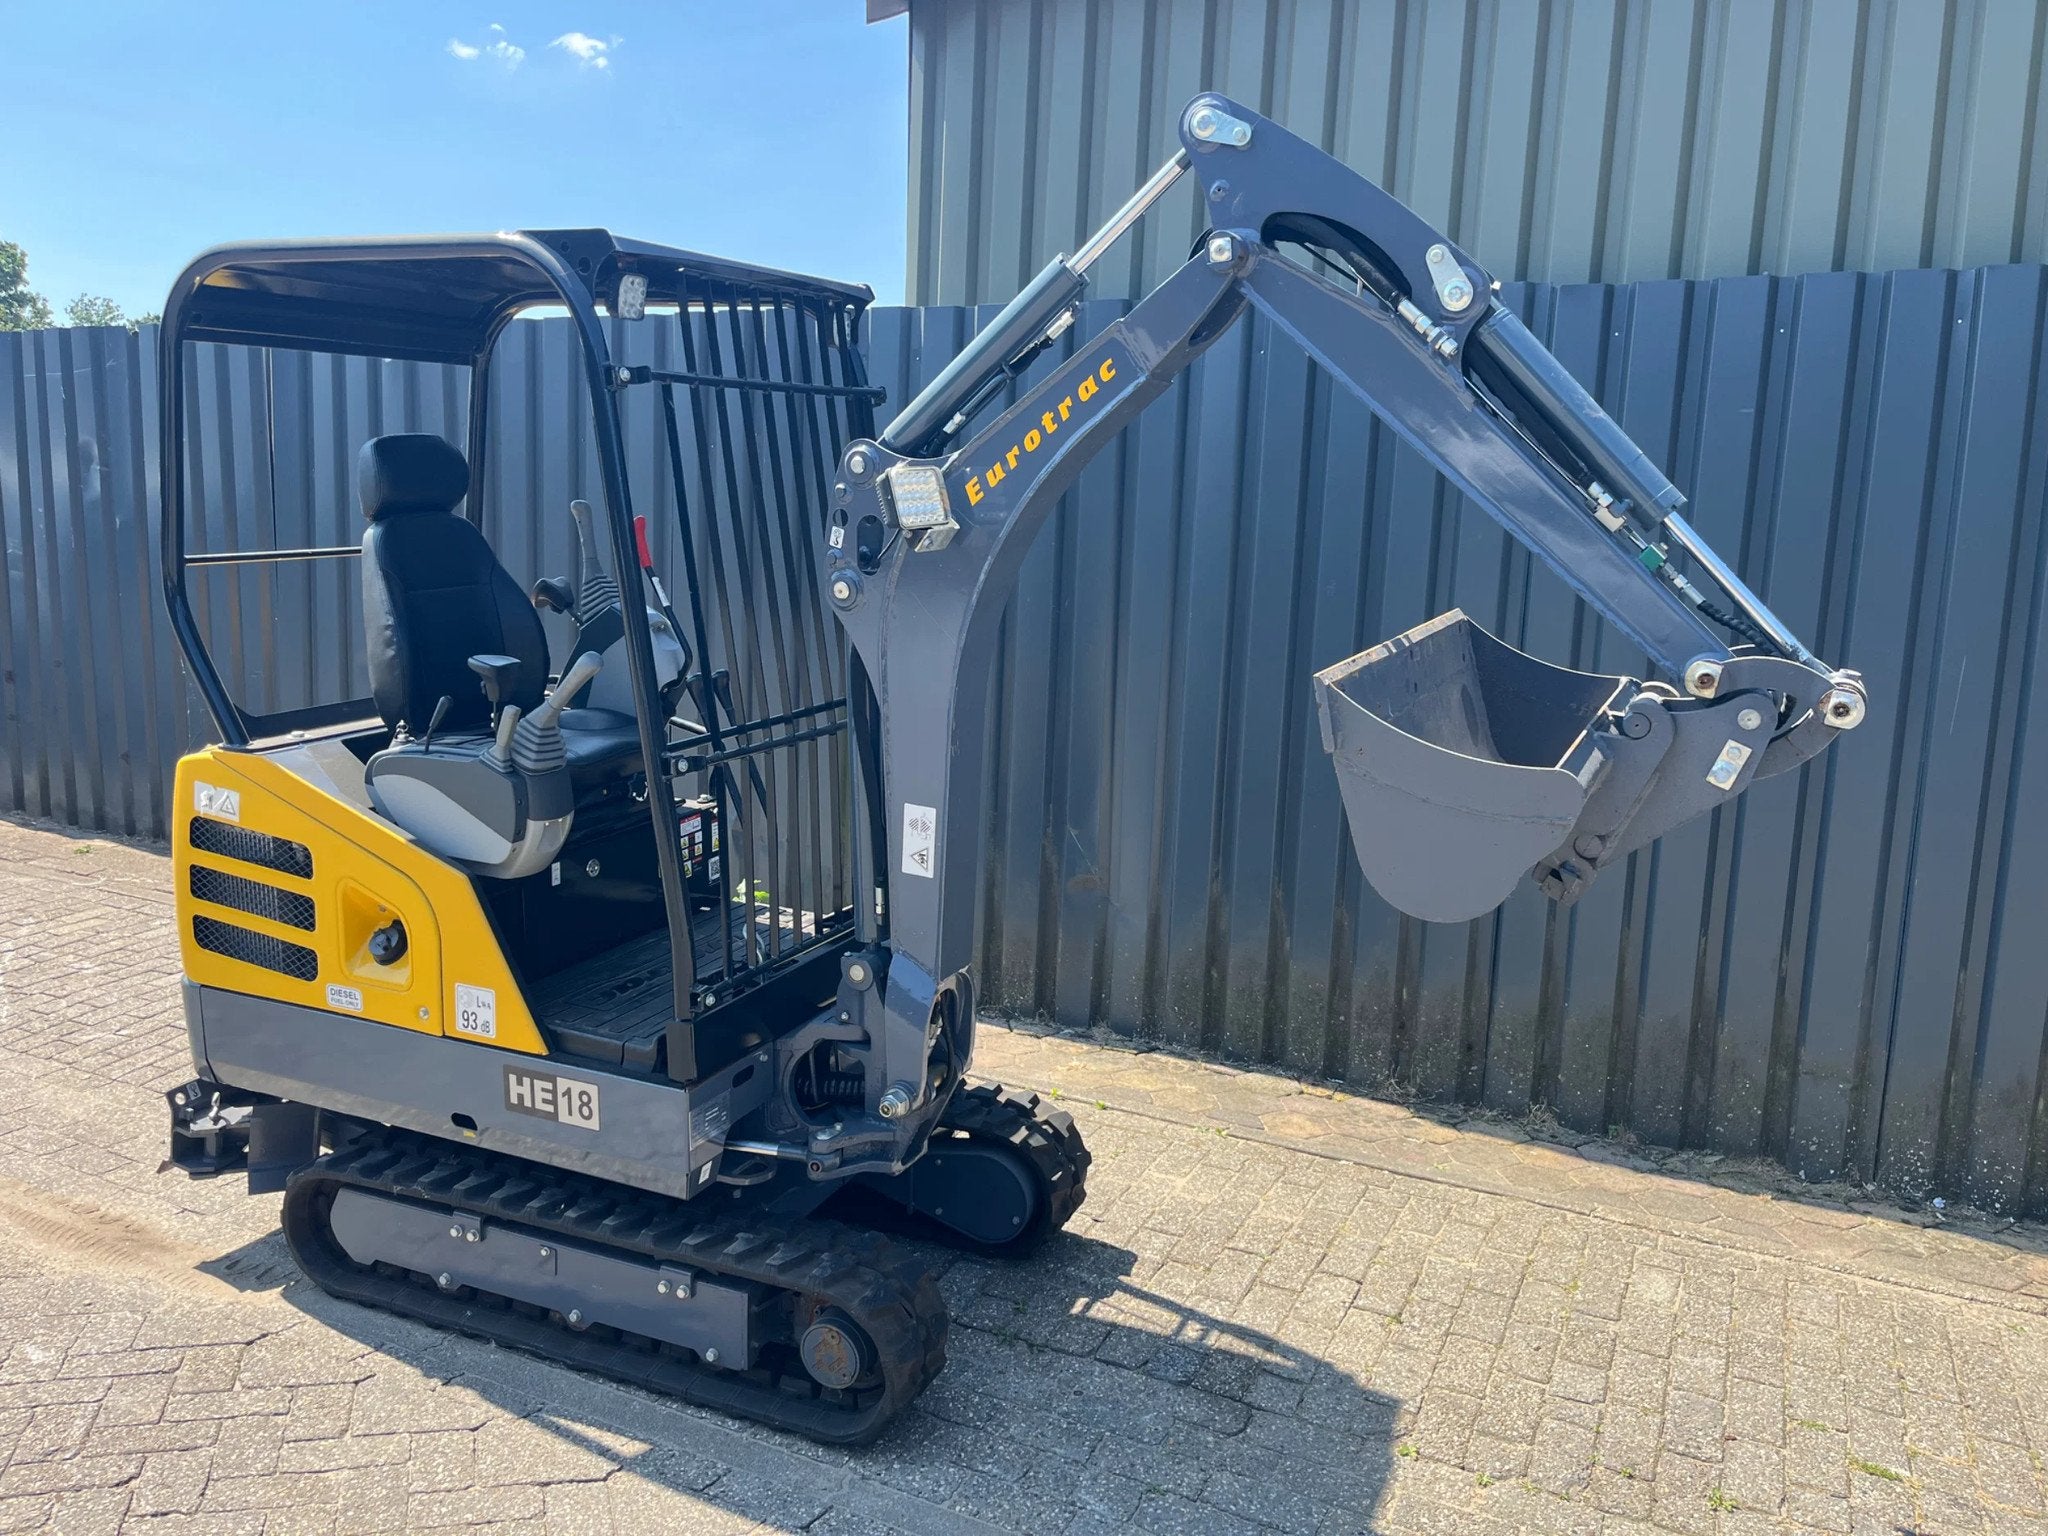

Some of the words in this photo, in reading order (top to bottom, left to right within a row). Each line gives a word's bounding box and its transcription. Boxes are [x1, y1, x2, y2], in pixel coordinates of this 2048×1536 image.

[965, 358, 1116, 507] Eurotrac
[330, 987, 359, 1001] DIESEL
[461, 1009, 478, 1031] 93
